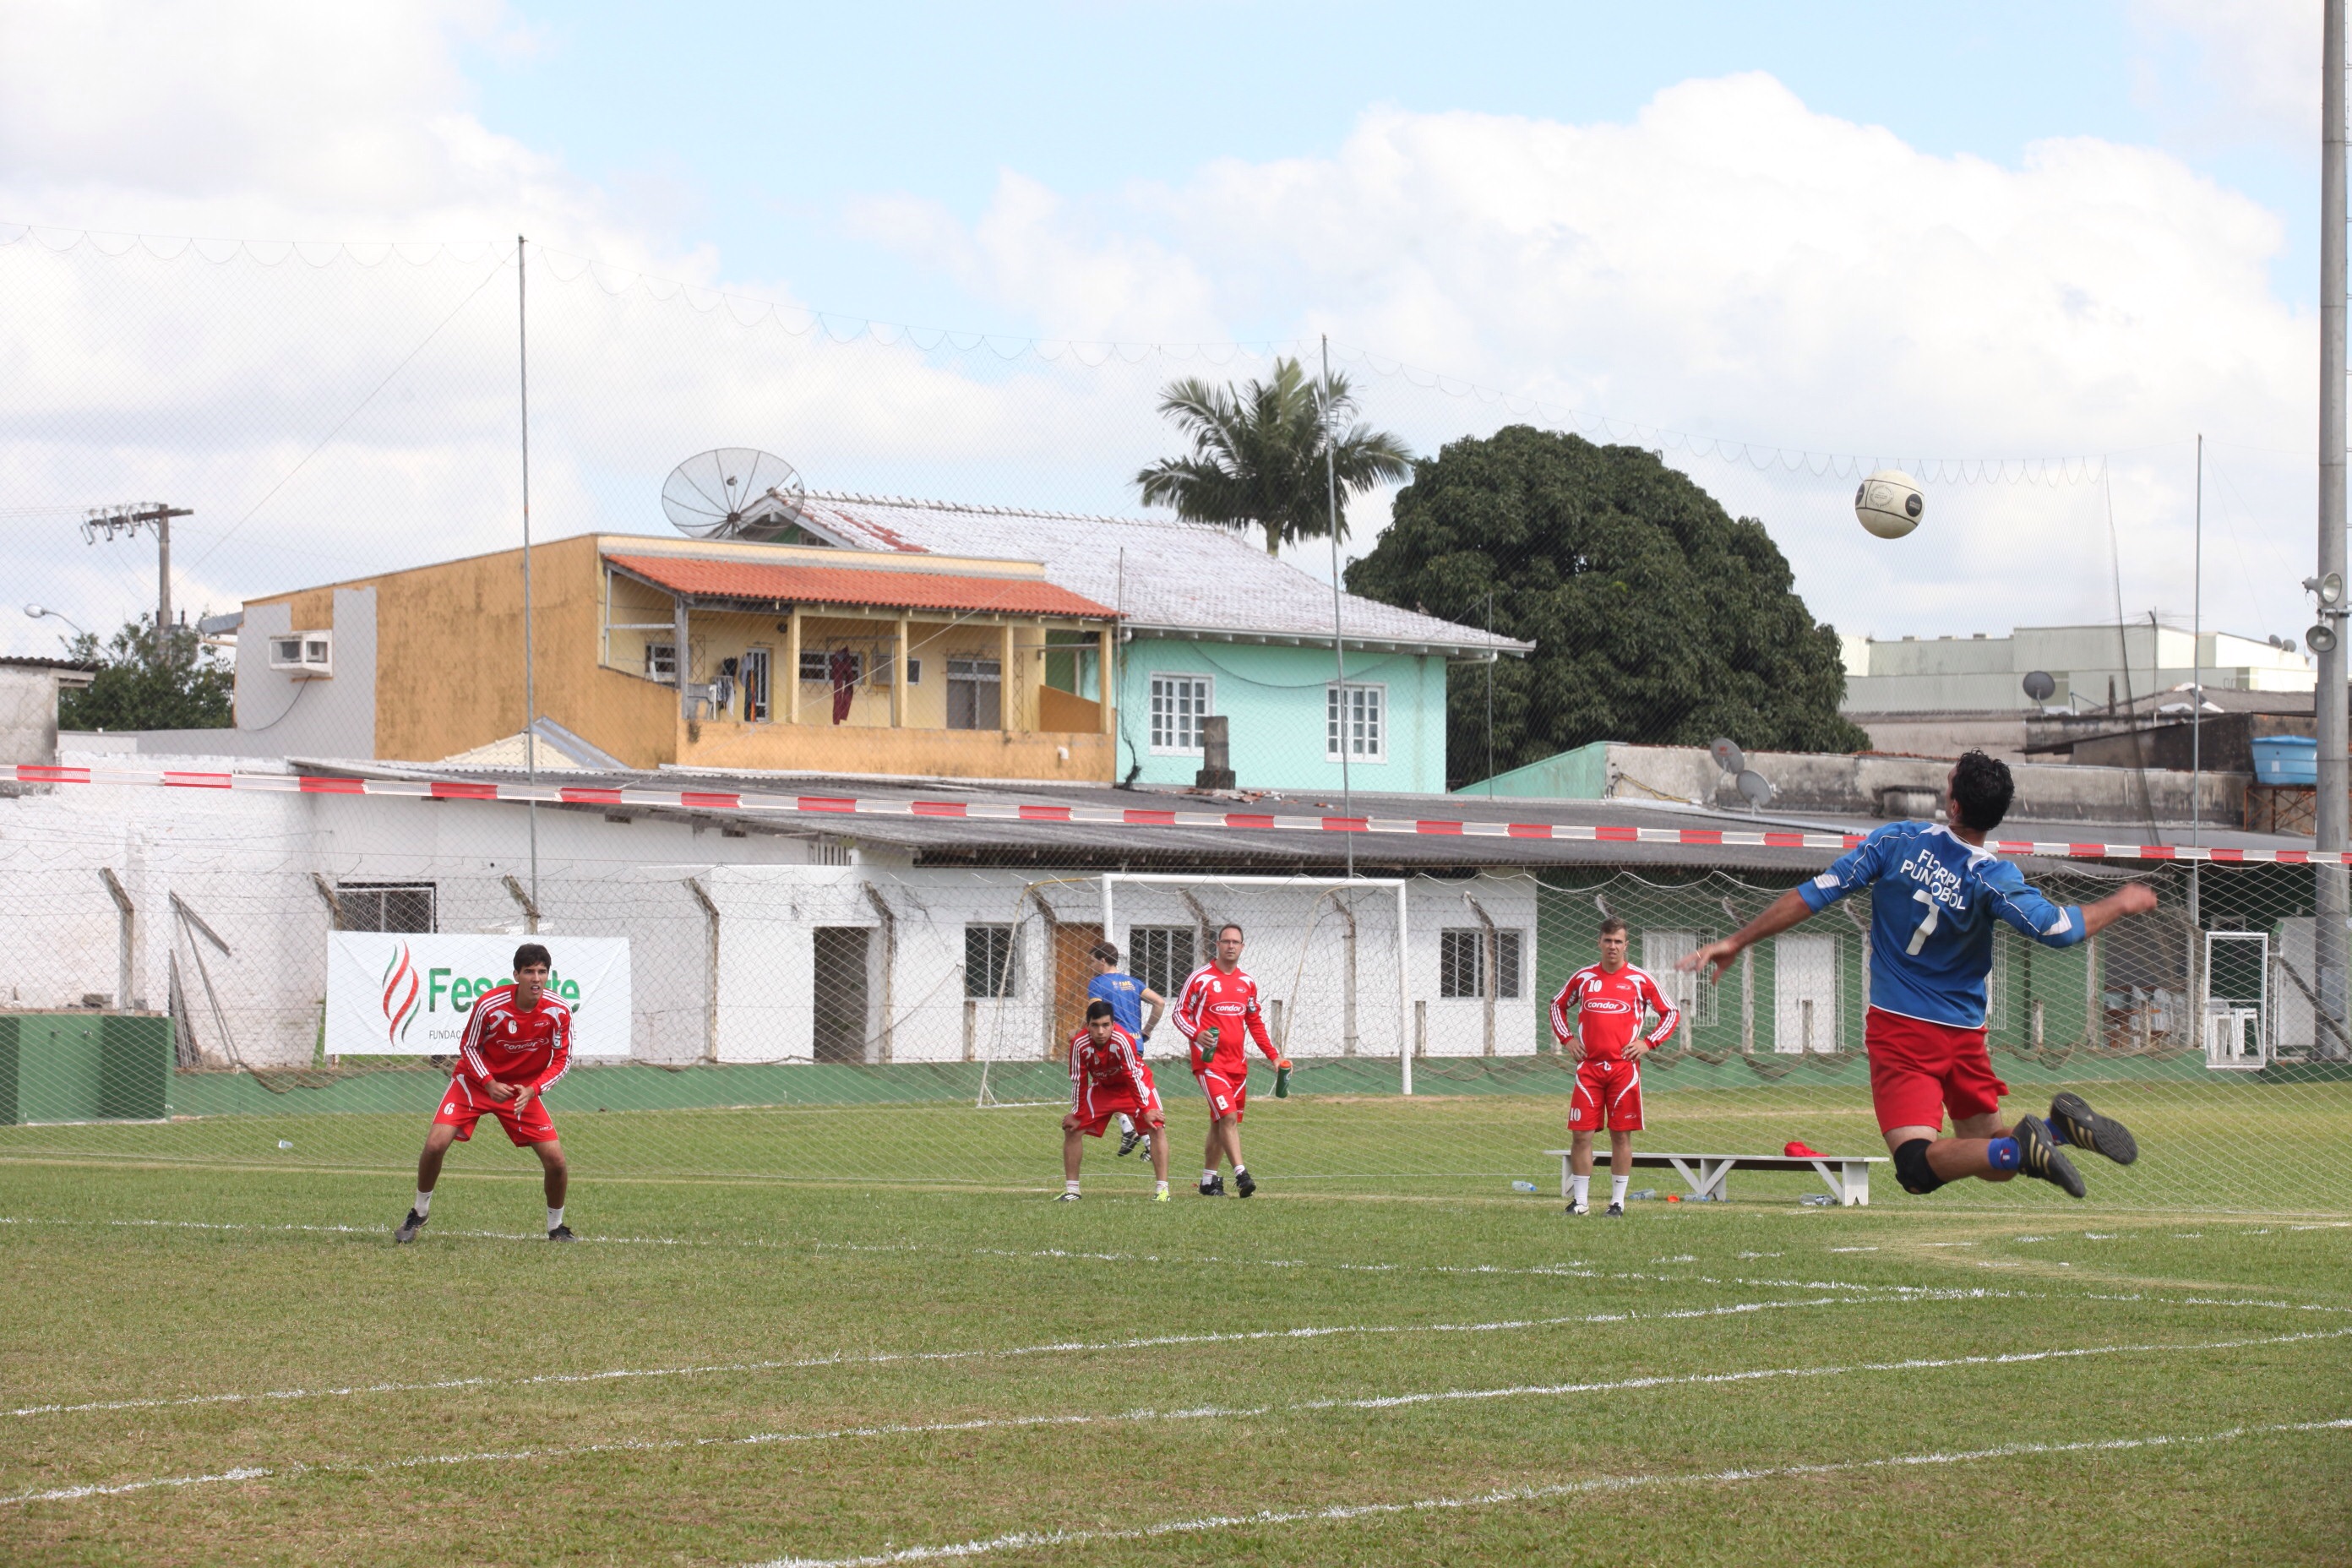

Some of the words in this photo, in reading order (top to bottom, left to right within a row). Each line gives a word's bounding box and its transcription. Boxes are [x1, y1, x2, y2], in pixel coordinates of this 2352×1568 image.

[1900, 859, 1966, 911] PUNOBOL
[1905, 889, 1941, 956] 7
[429, 968, 580, 1013] Feste
[1212, 980, 1222, 993] 8
[1588, 980, 1603, 993] 10
[1587, 1001, 1620, 1010] condor
[508, 1020, 518, 1034] 6
[429, 1029, 463, 1042] FUNDAÇ
[504, 1042, 538, 1050] condor
[444, 1102, 455, 1115] 6
[1570, 1107, 1582, 1122] 10
